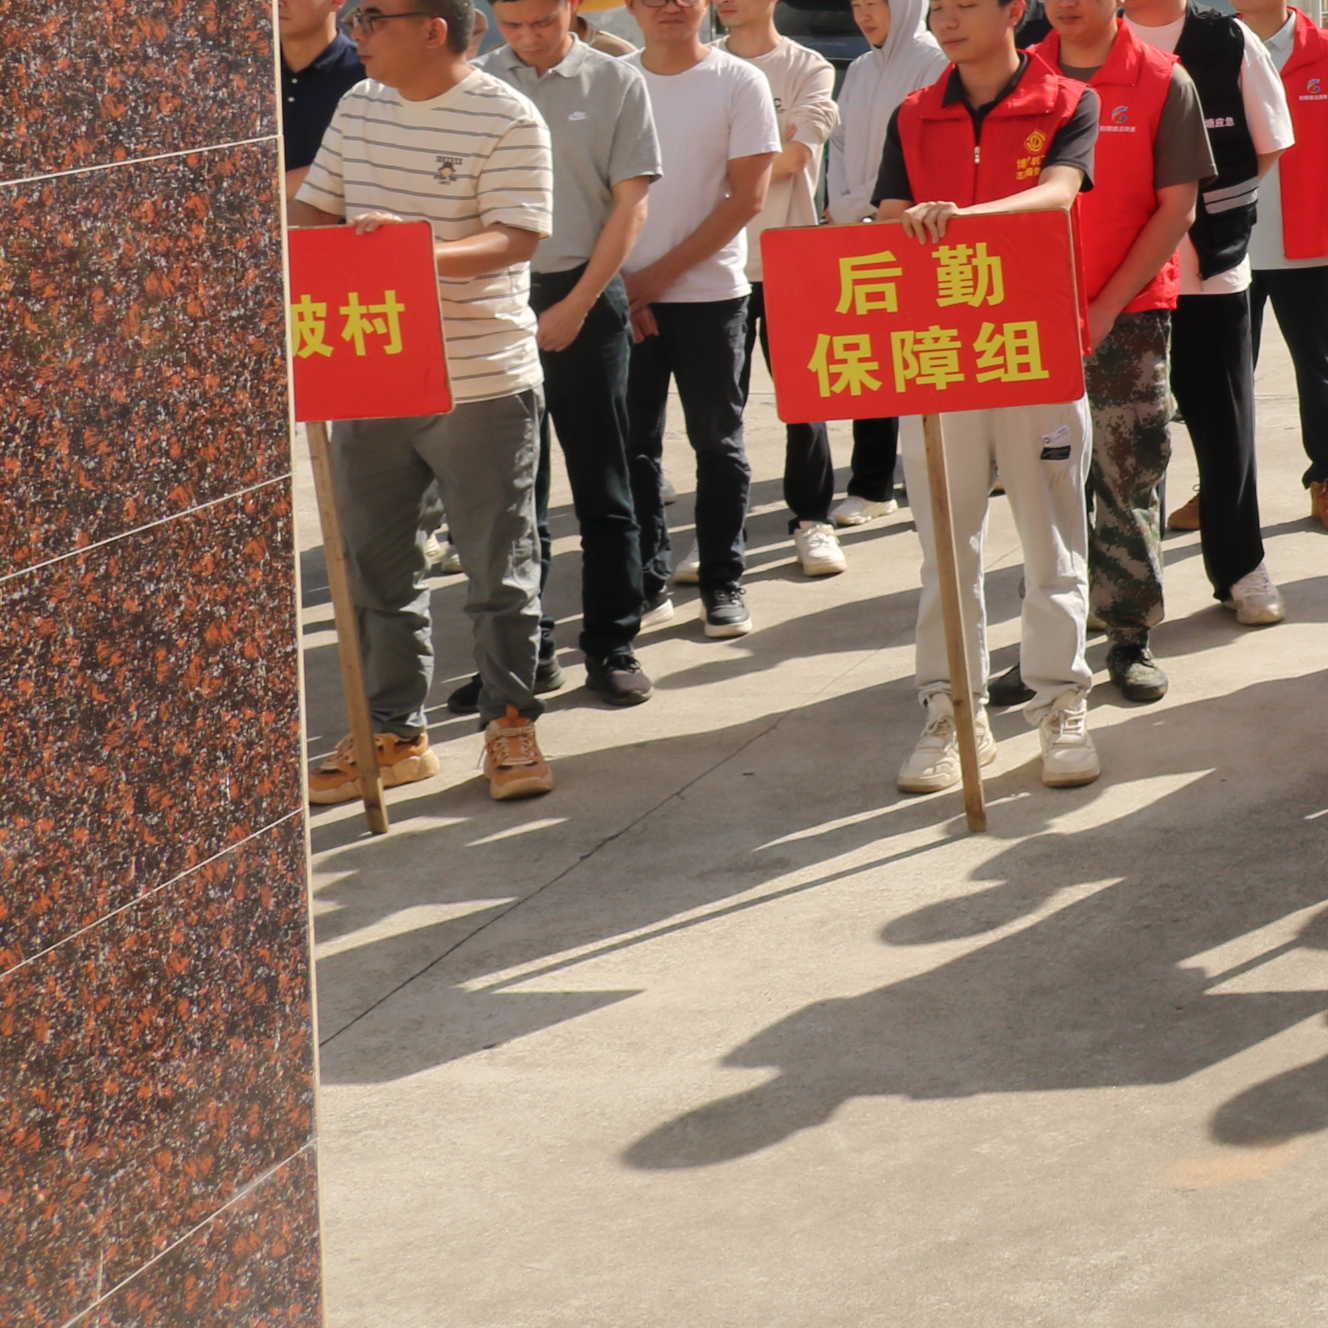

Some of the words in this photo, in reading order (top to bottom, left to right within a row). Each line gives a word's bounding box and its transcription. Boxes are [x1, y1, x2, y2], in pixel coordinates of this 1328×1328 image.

[836, 242, 1005, 315] 后勤
[807, 320, 1050, 398] 保障组
